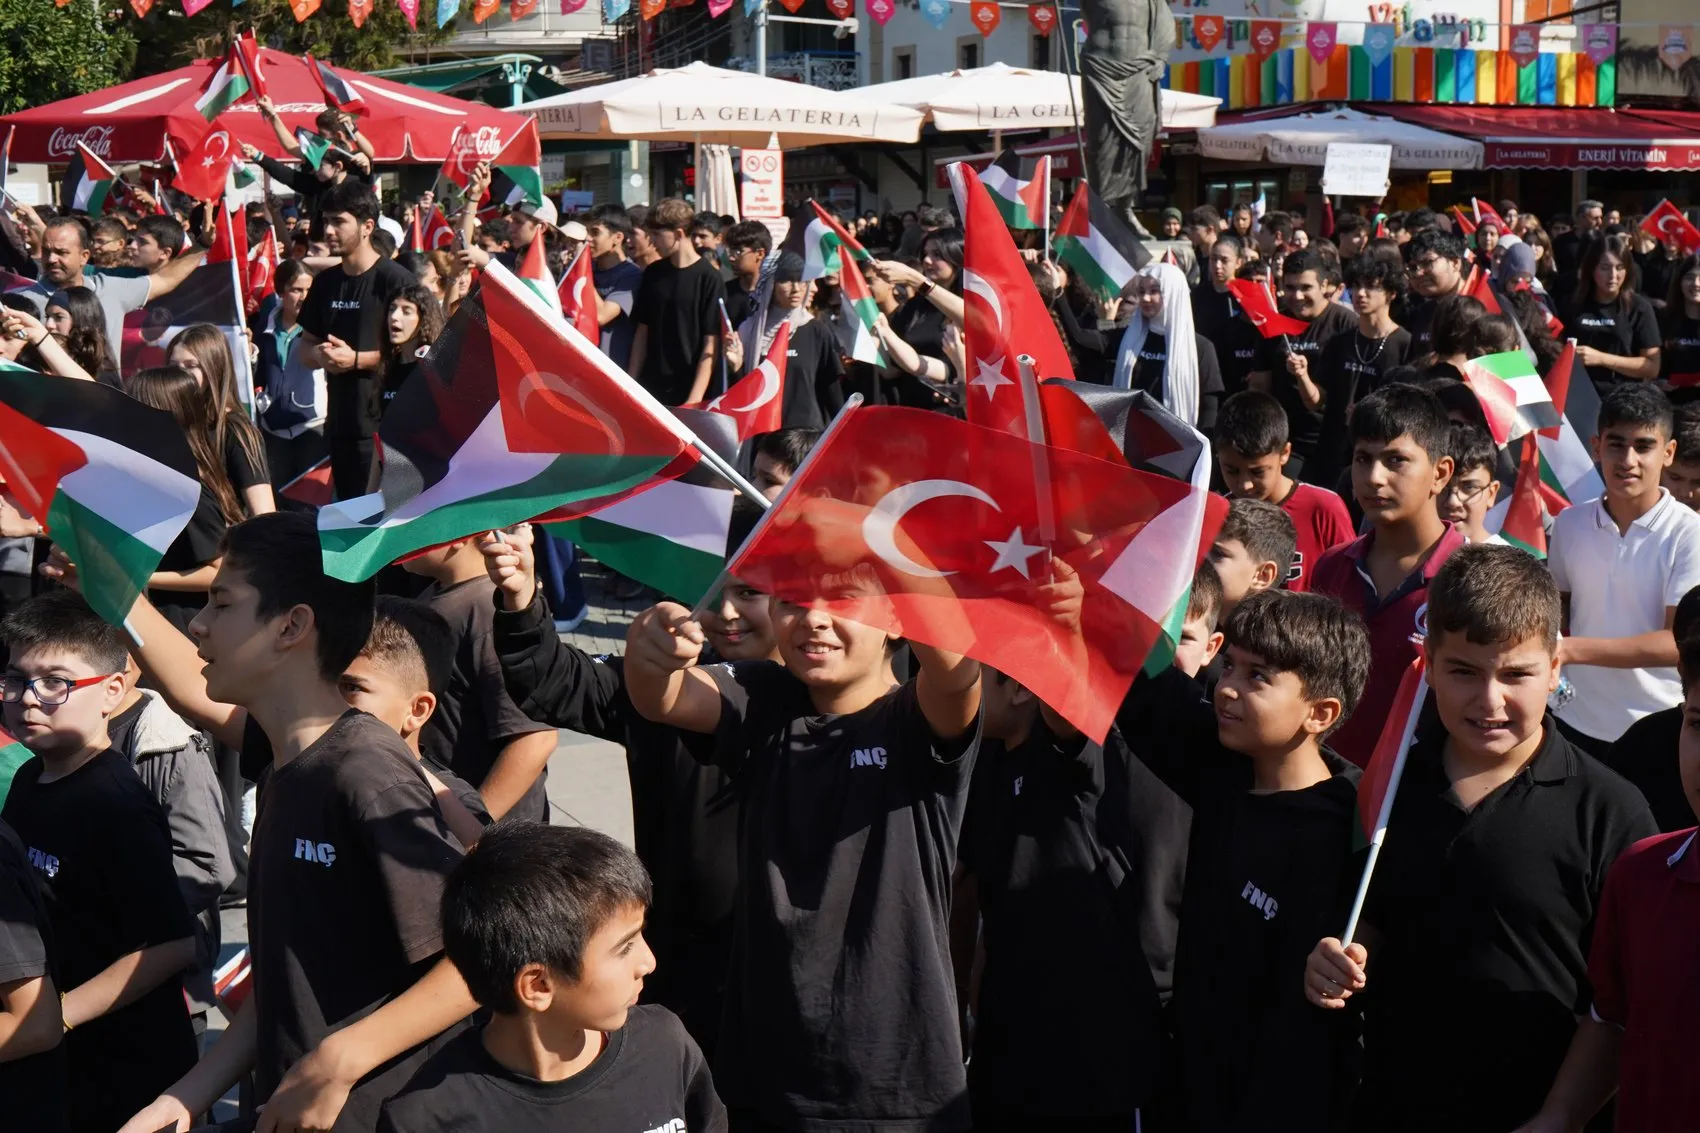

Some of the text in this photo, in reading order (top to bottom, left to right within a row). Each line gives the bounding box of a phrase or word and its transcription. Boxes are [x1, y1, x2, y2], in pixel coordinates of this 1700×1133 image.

[676, 106, 862, 128] LA GELATERIA
[992, 105, 1020, 119] LA
[1278, 143, 1293, 153] LA
[1398, 149, 1411, 158] LA
[1414, 149, 1470, 160] GELATERIA
[295, 837, 336, 867] FNÇ
[1241, 880, 1278, 920] FNÇ
